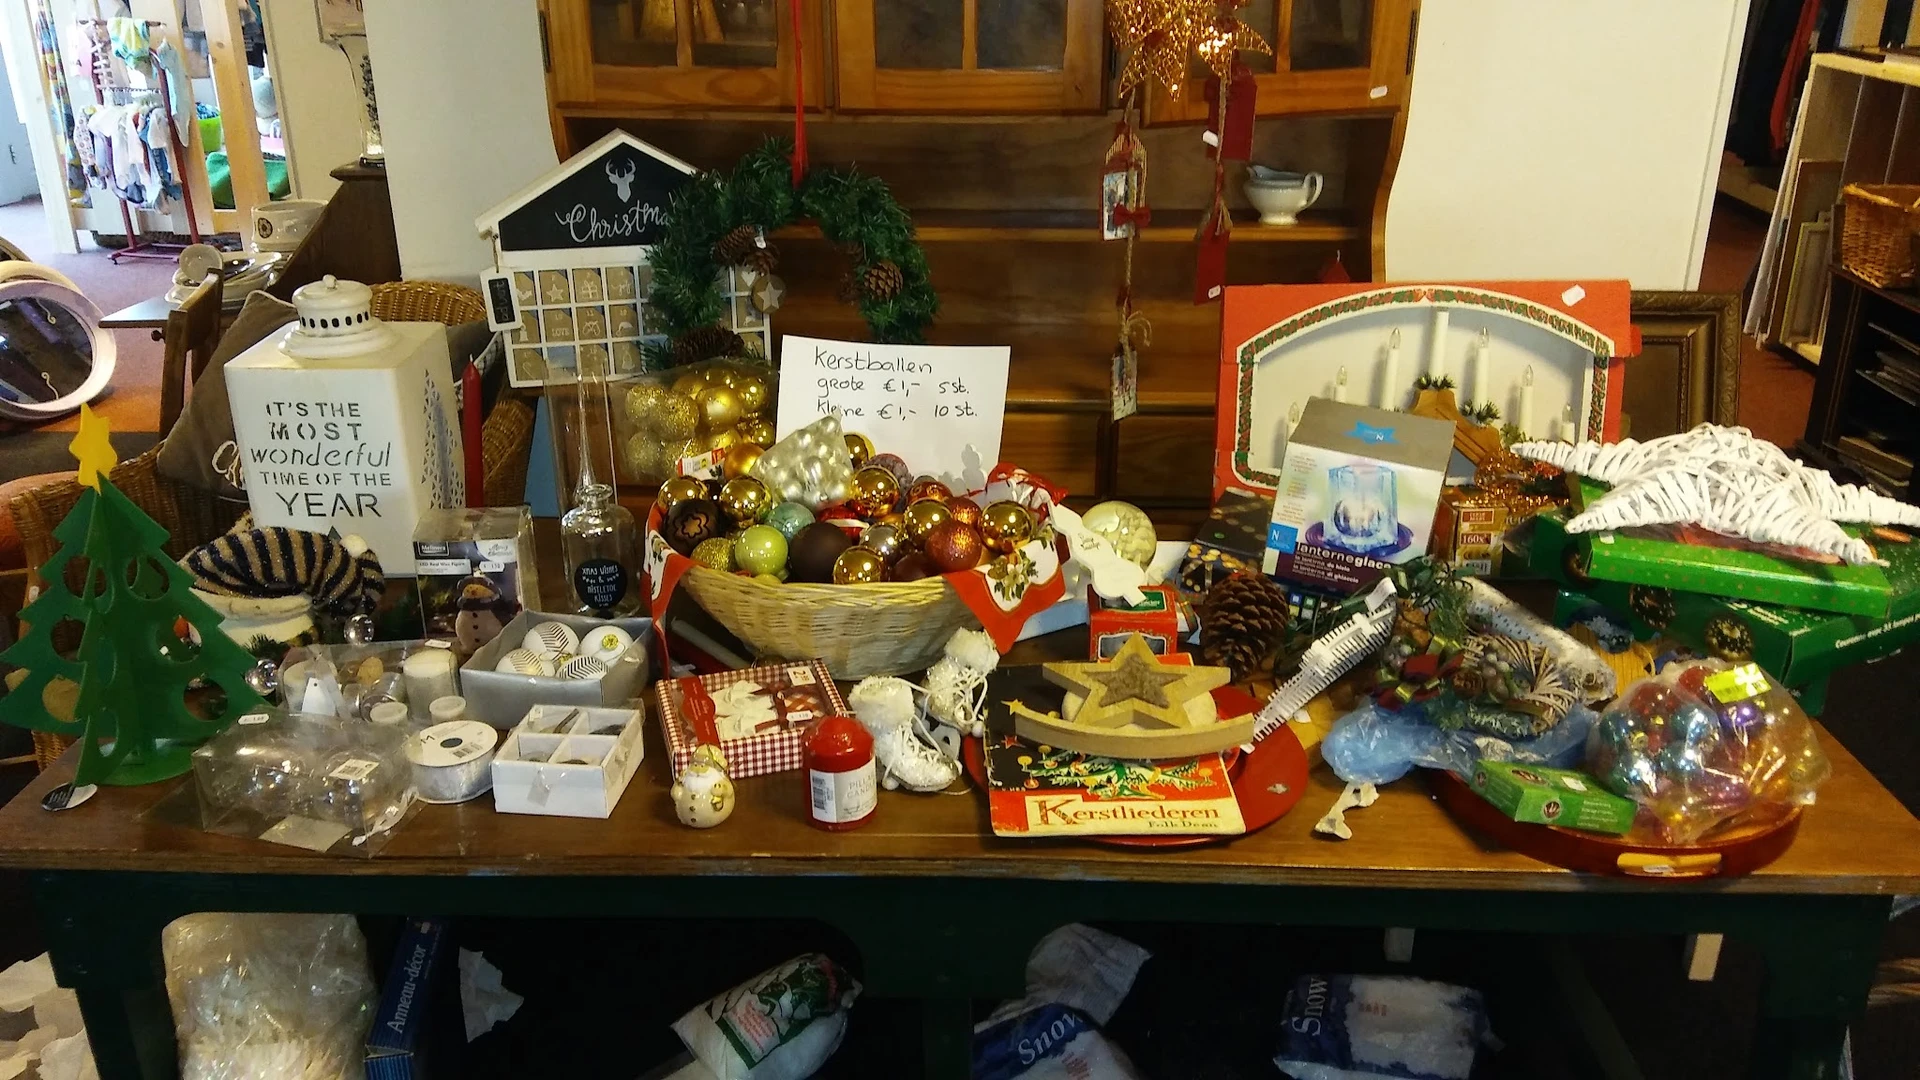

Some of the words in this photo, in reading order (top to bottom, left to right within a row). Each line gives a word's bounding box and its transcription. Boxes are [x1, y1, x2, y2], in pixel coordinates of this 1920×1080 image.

[817, 376, 865, 399] grote
[266, 402, 309, 417] IT'S
[315, 402, 361, 417] THE
[268, 422, 362, 441] MOST
[250, 443, 391, 467] wonderful
[259, 471, 310, 486] TIME
[316, 472, 342, 485] OF
[350, 472, 392, 486] THE
[276, 491, 382, 518] YEAR
[1034, 799, 1220, 826] Kerstliederen
[387, 944, 427, 1034] Anneau-décor
[1292, 976, 1328, 1037] Snow
